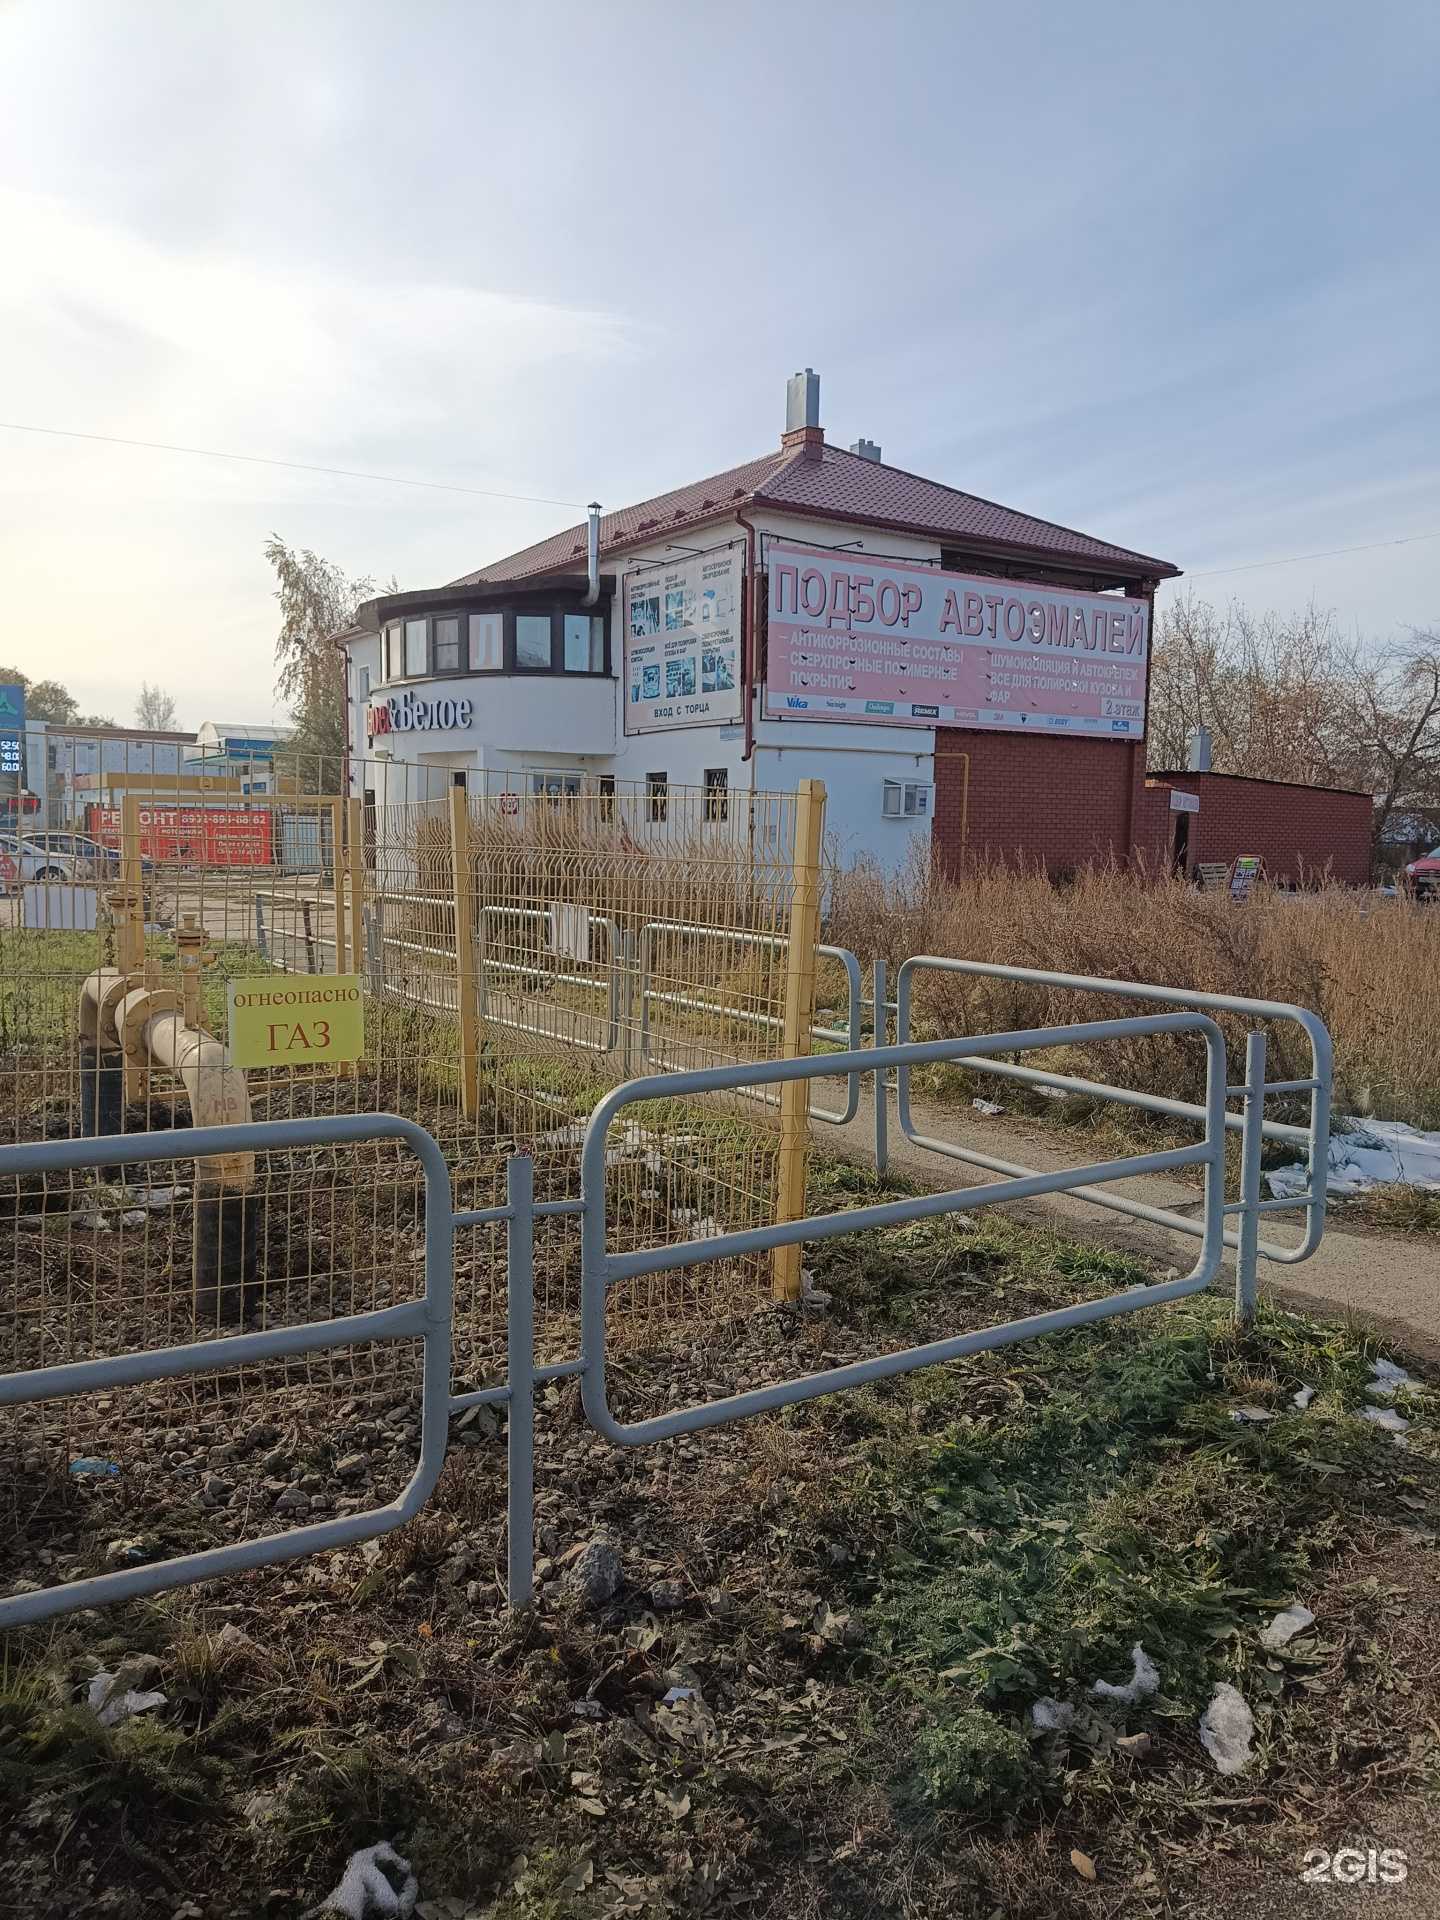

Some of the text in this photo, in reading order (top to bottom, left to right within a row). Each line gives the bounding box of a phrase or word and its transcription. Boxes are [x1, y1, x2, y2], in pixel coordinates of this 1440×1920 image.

[775, 563, 1143, 655] ПОДБОР АВТОЭМАЛЕЙ
[790, 631, 964, 664] АНТИКОРРОЗИОННЫЕ СОСТАВЫ
[790, 652, 958, 681] СВЕРХПРОЧНЫЕ ПОЛИМЕРНЫЕ
[991, 653, 1071, 675] ШУМОИЗОЛЯЦИЯ
[790, 671, 853, 689] ПОКРЫТИЯ
[1011, 674, 1033, 688] ДЛЯ
[654, 703, 710, 718] ВХОД С ТОРЦА
[787, 695, 809, 709] Vika
[1105, 700, 1140, 717] 2 этаж
[101, 811, 178, 825] РЕОНТ
[233, 987, 360, 1008] огнеопасно
[265, 1020, 330, 1051] ГАЗ
